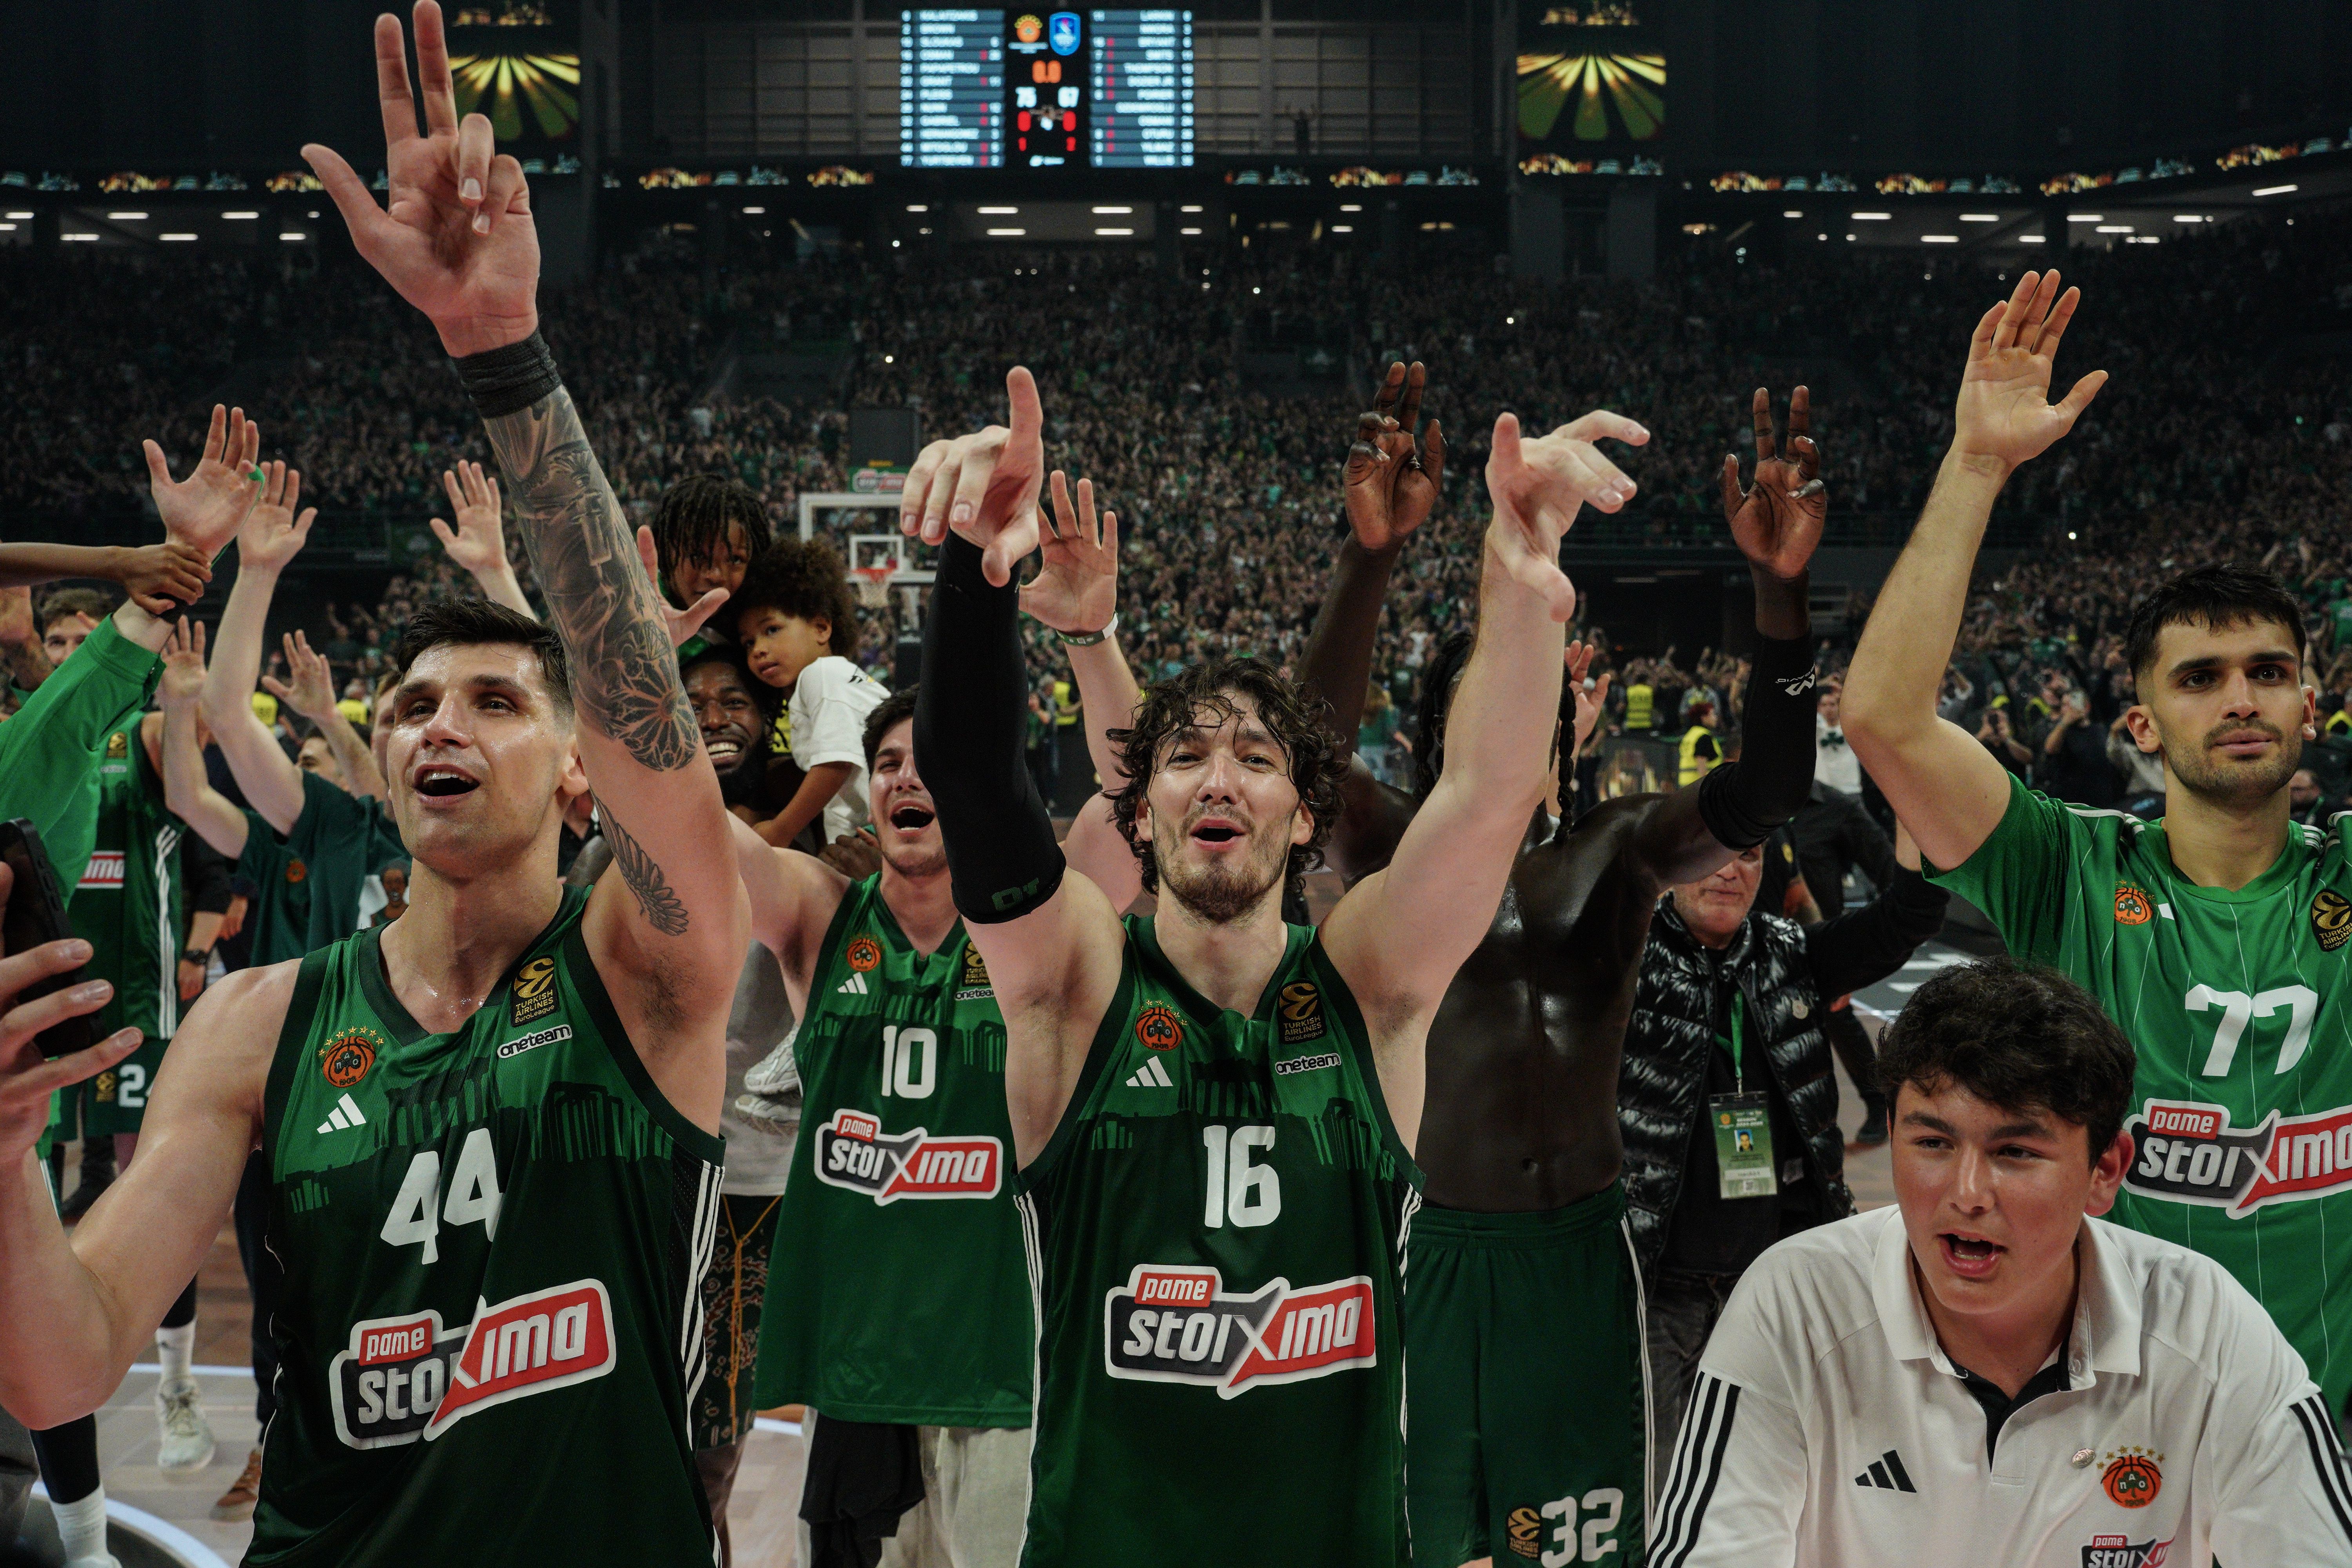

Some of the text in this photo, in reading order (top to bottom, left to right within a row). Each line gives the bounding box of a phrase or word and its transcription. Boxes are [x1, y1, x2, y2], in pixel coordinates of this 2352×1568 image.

[515, 989, 553, 1010] TURKISH
[955, 988, 994, 1000] onetea
[515, 996, 554, 1018] AIRLINES
[515, 1005, 554, 1023] EuroLeague
[1283, 1015, 1321, 1029] TURKISH
[1284, 1022, 1322, 1036] AIRLINES
[2185, 983, 2318, 1077] 77
[500, 1026, 571, 1058] oneteam
[1284, 1029, 1323, 1041] EuroLeague
[881, 1025, 937, 1099] 10
[1276, 1054, 1341, 1073] oneteam
[118, 1063, 154, 1108] 2
[840, 1117, 874, 1138] pame
[2152, 1109, 2214, 1134] pame
[1203, 1125, 1281, 1229] 16
[380, 1127, 505, 1265] 44
[1142, 1277, 1207, 1301] pame
[366, 1327, 425, 1361] pame
[1541, 1487, 1624, 1568] 32
[2095, 1537, 2123, 1547] pame
